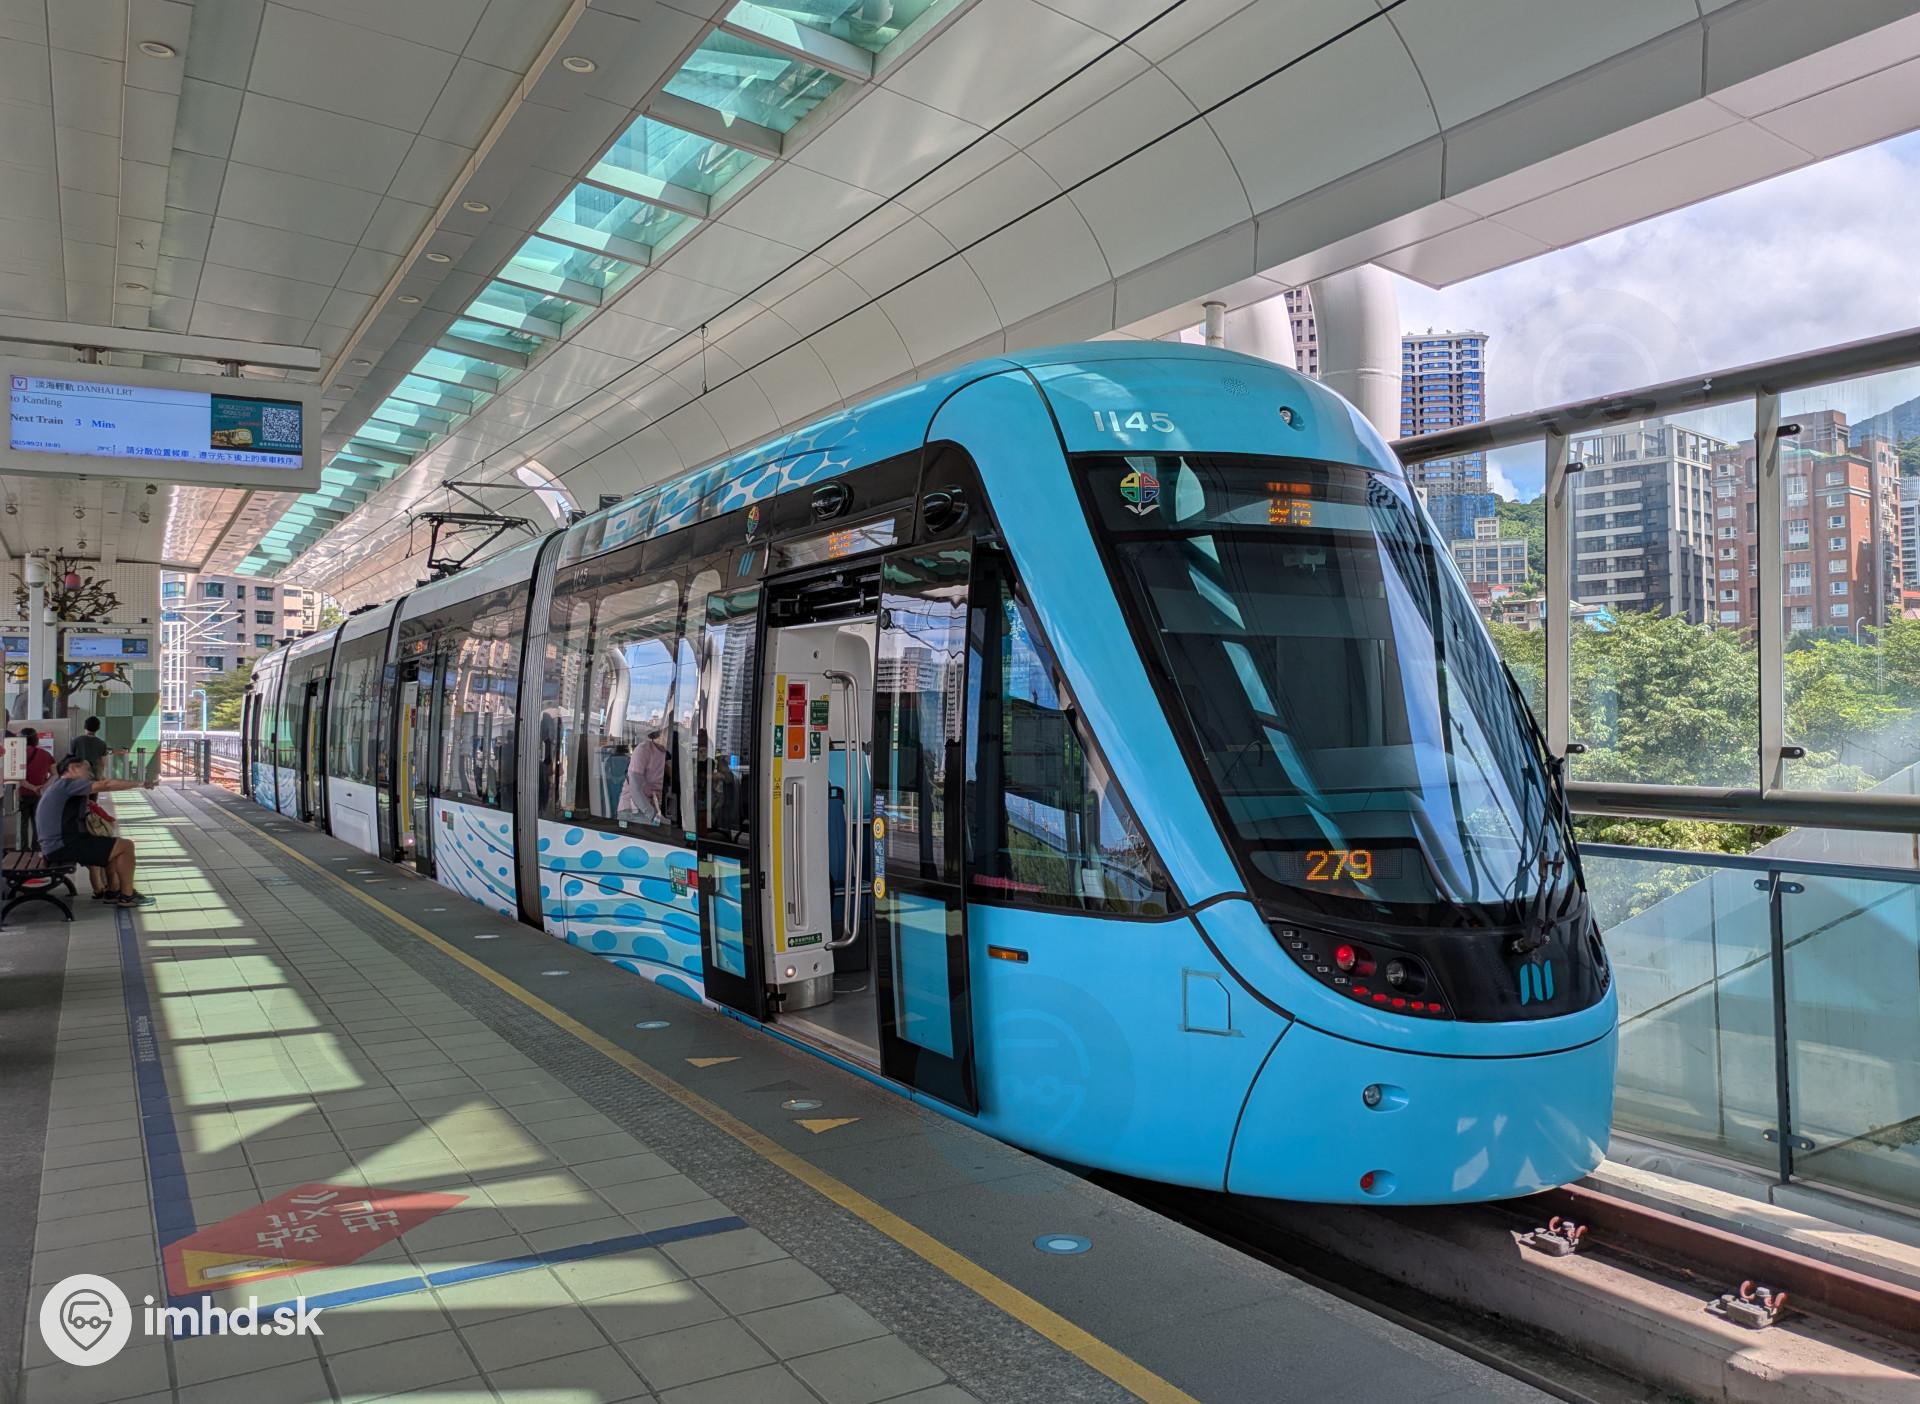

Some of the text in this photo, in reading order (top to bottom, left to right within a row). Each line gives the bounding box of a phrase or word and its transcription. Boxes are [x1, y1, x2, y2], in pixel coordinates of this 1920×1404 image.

[35, 380, 74, 392] 淡海輕軌
[77, 385, 133, 396] DANHAI LRT
[23, 395, 62, 408] Kanding
[10, 413, 116, 429] Next Train 3 Mins
[1093, 411, 1175, 433] 1145
[1306, 850, 1372, 880] 279
[266, 1199, 375, 1228] Exit
[256, 1210, 400, 1248] 出站
